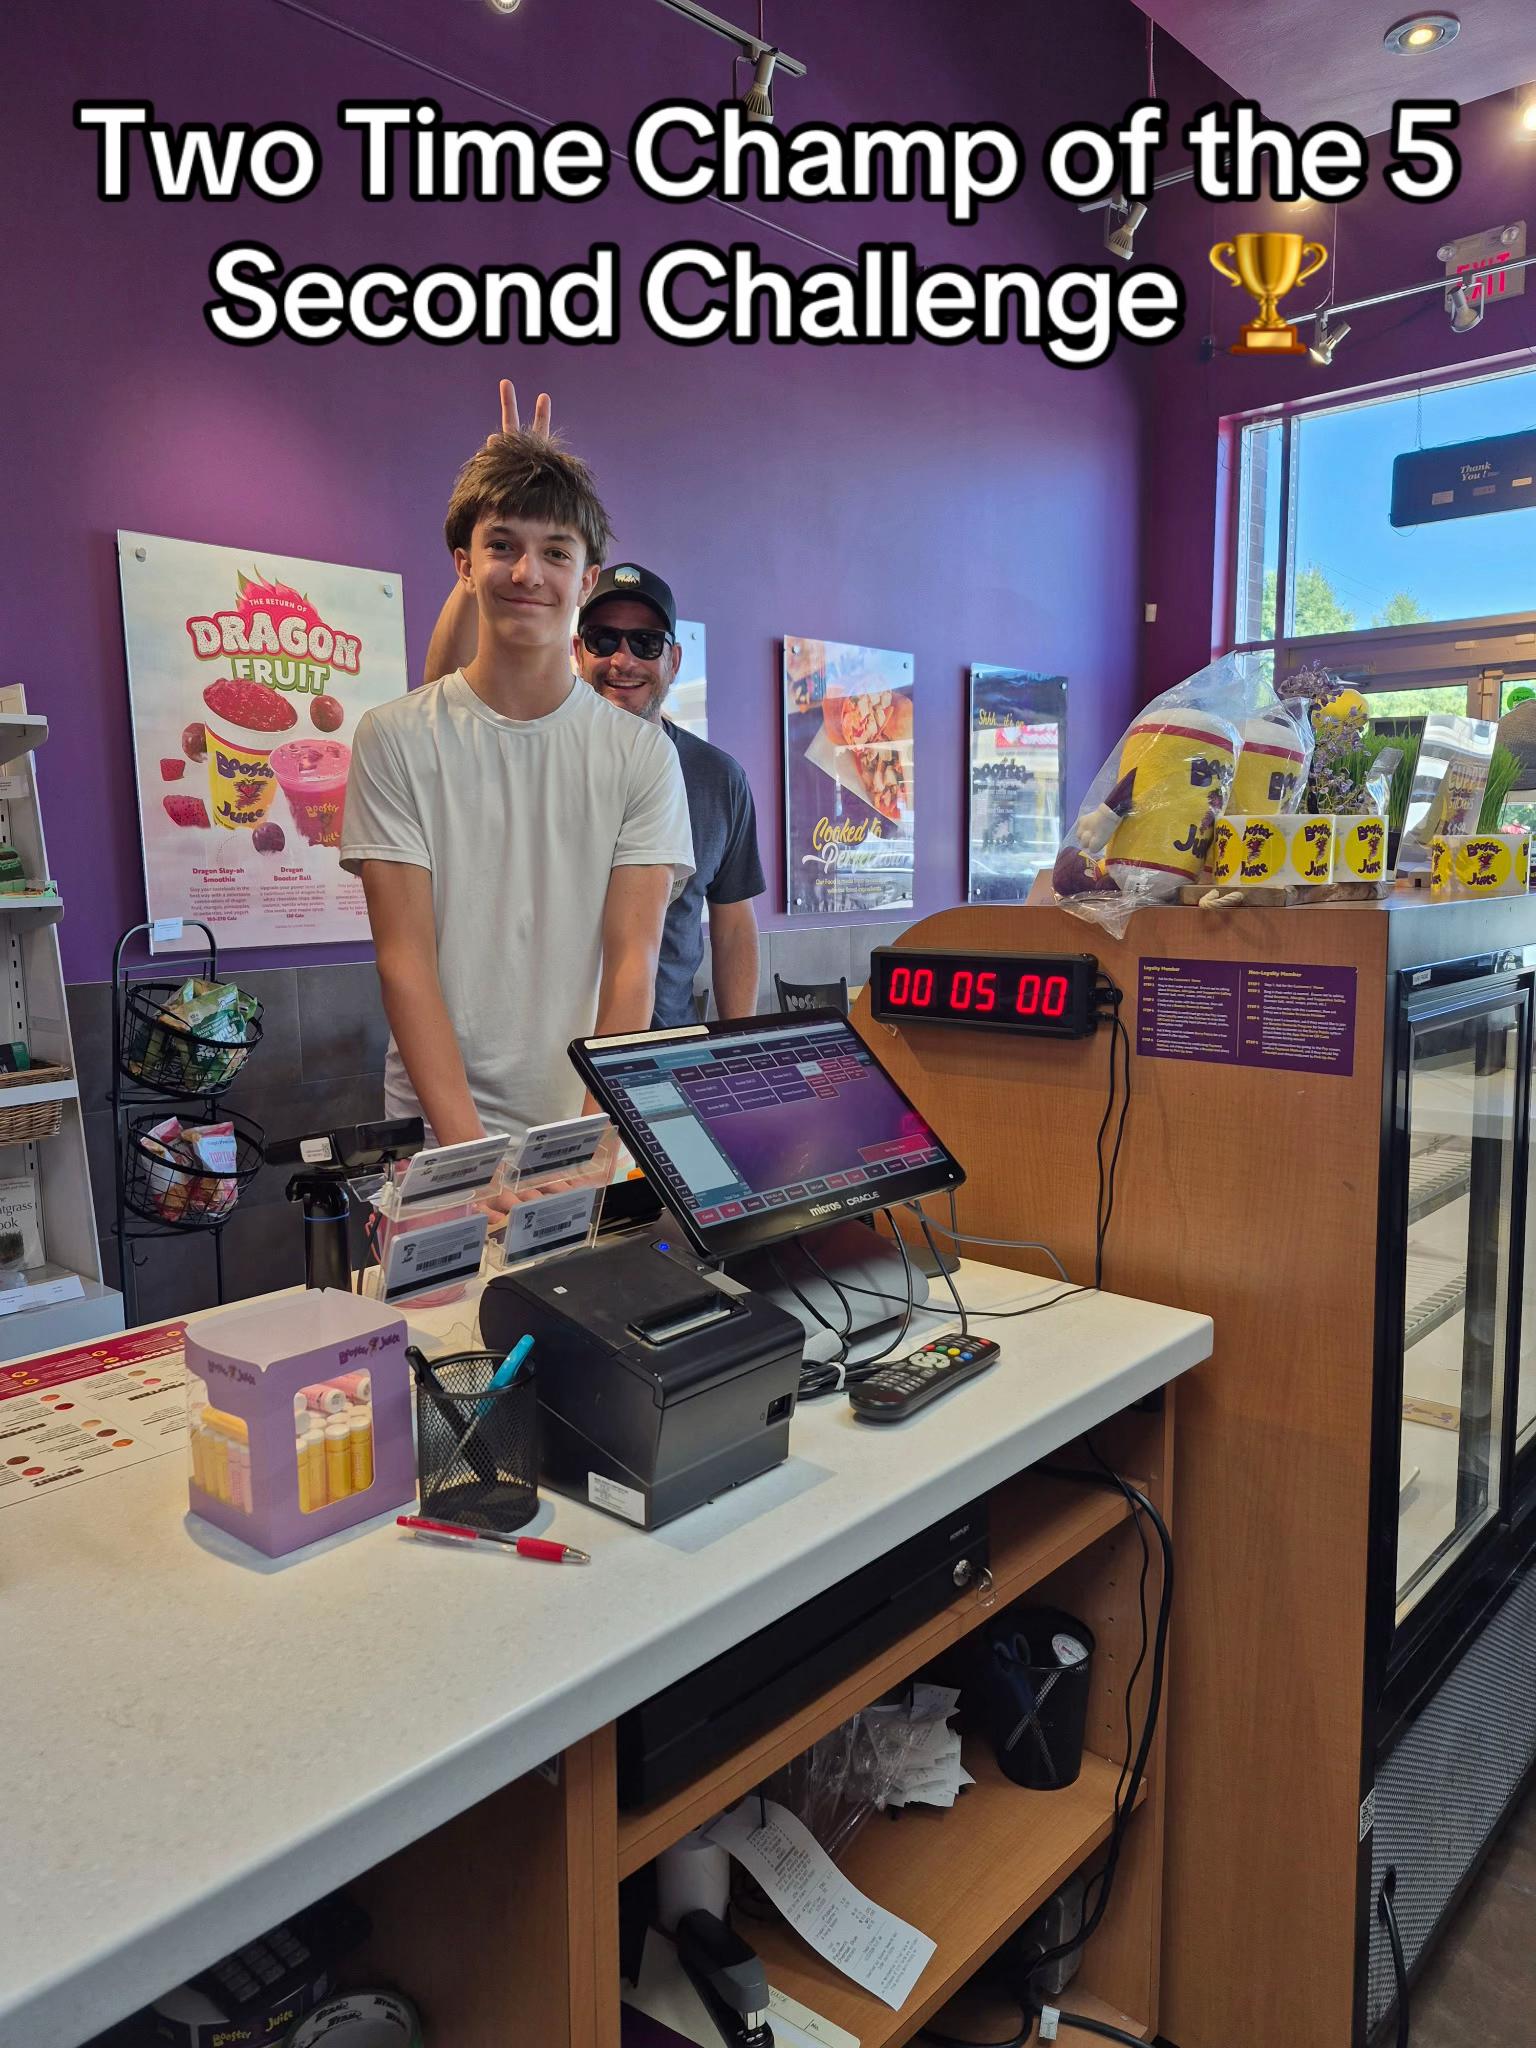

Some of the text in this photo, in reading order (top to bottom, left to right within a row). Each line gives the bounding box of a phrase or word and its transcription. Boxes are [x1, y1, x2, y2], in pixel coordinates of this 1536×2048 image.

[1461, 461, 1492, 474] Thank
[1462, 472, 1480, 481] You
[249, 598, 307, 613] THE RETURN OF
[189, 611, 359, 670] DRAGON
[233, 657, 328, 691] FRUIT
[216, 800, 265, 824] Juice
[304, 801, 340, 818] Booster
[812, 816, 869, 851] Cooked
[1466, 841, 1503, 858] Booster
[192, 867, 218, 875] Dragon
[280, 866, 304, 874] Dragon
[1467, 872, 1498, 886] Juice
[888, 966, 1068, 1017] 00 05 00
[809, 1191, 880, 1217] micros ORACLE
[338, 1344, 369, 1365] Booster
[212, 2030, 252, 2048] Booster
[265, 2009, 294, 2032] Juice
